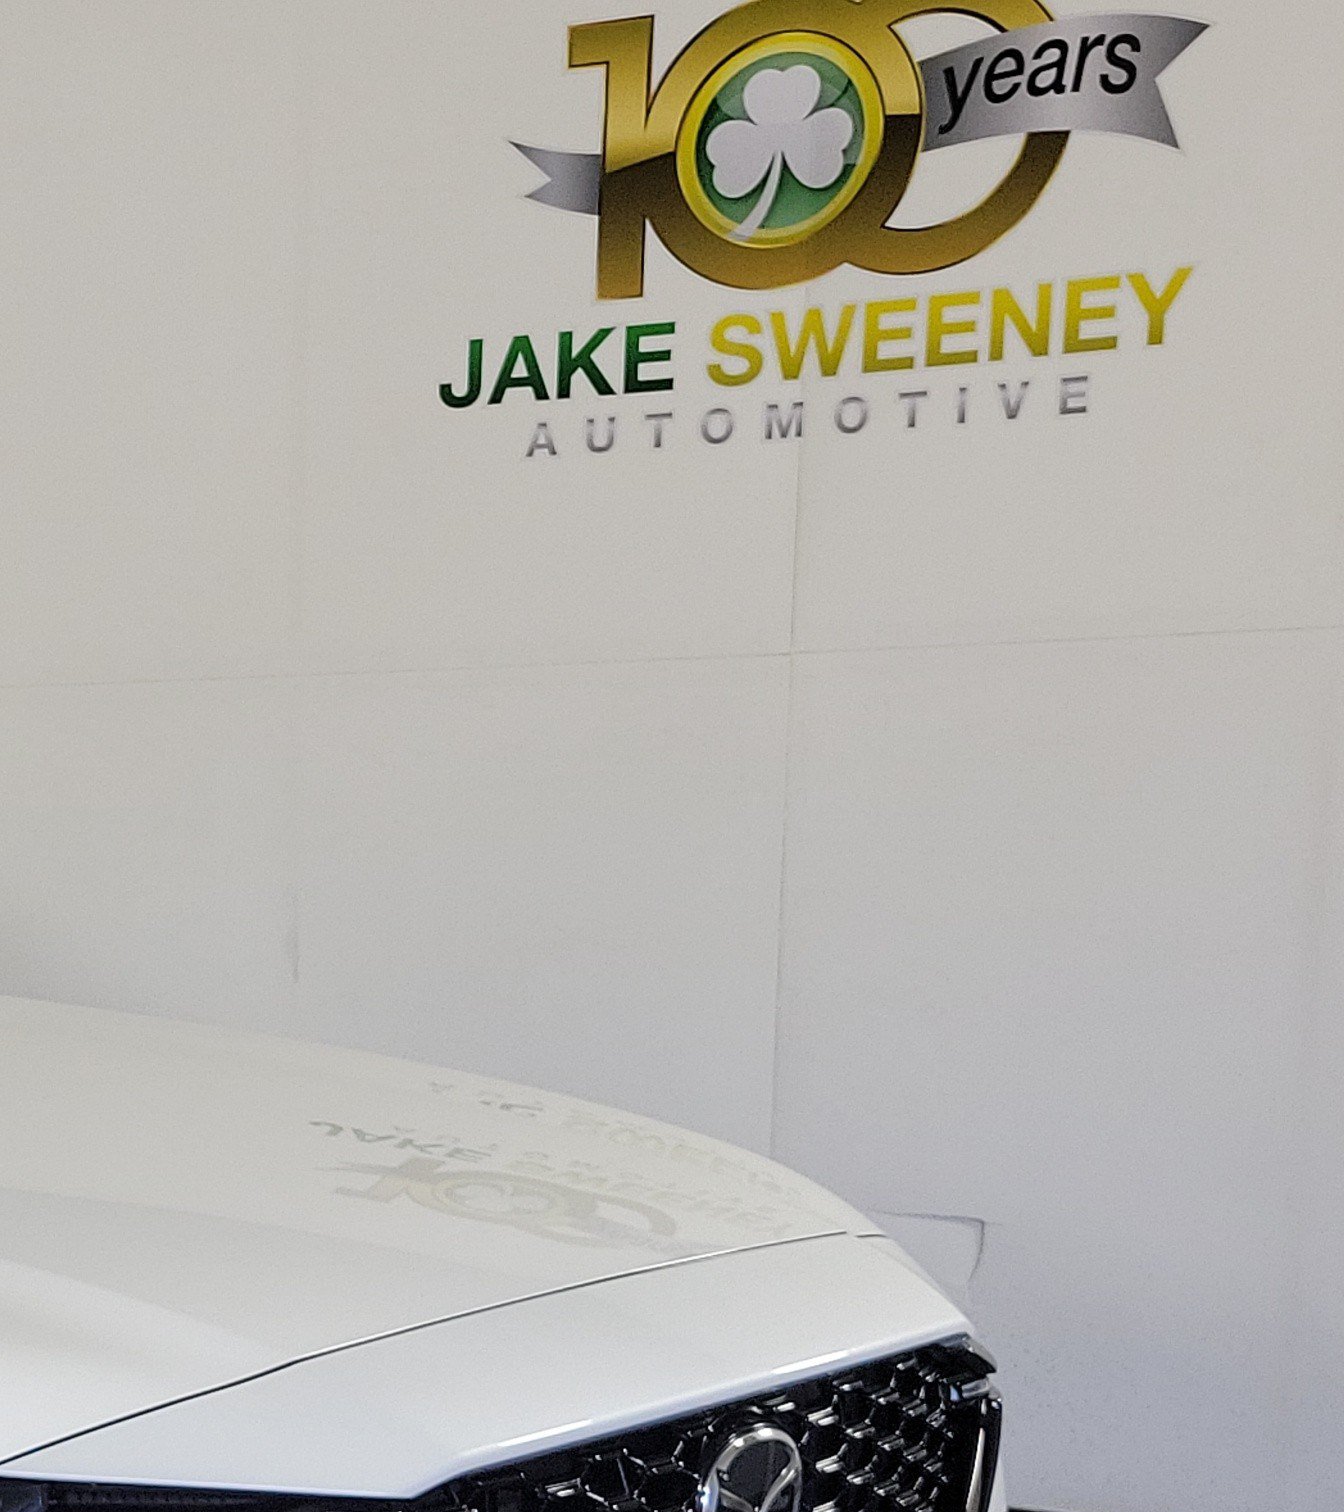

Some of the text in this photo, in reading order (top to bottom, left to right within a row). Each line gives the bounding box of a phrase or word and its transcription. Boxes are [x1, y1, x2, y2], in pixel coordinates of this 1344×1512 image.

[567, 0, 1142, 301] 100 years
[438, 266, 1194, 410] JAKE SWEENEY
[525, 375, 1091, 459] AUTOMOTIVE
